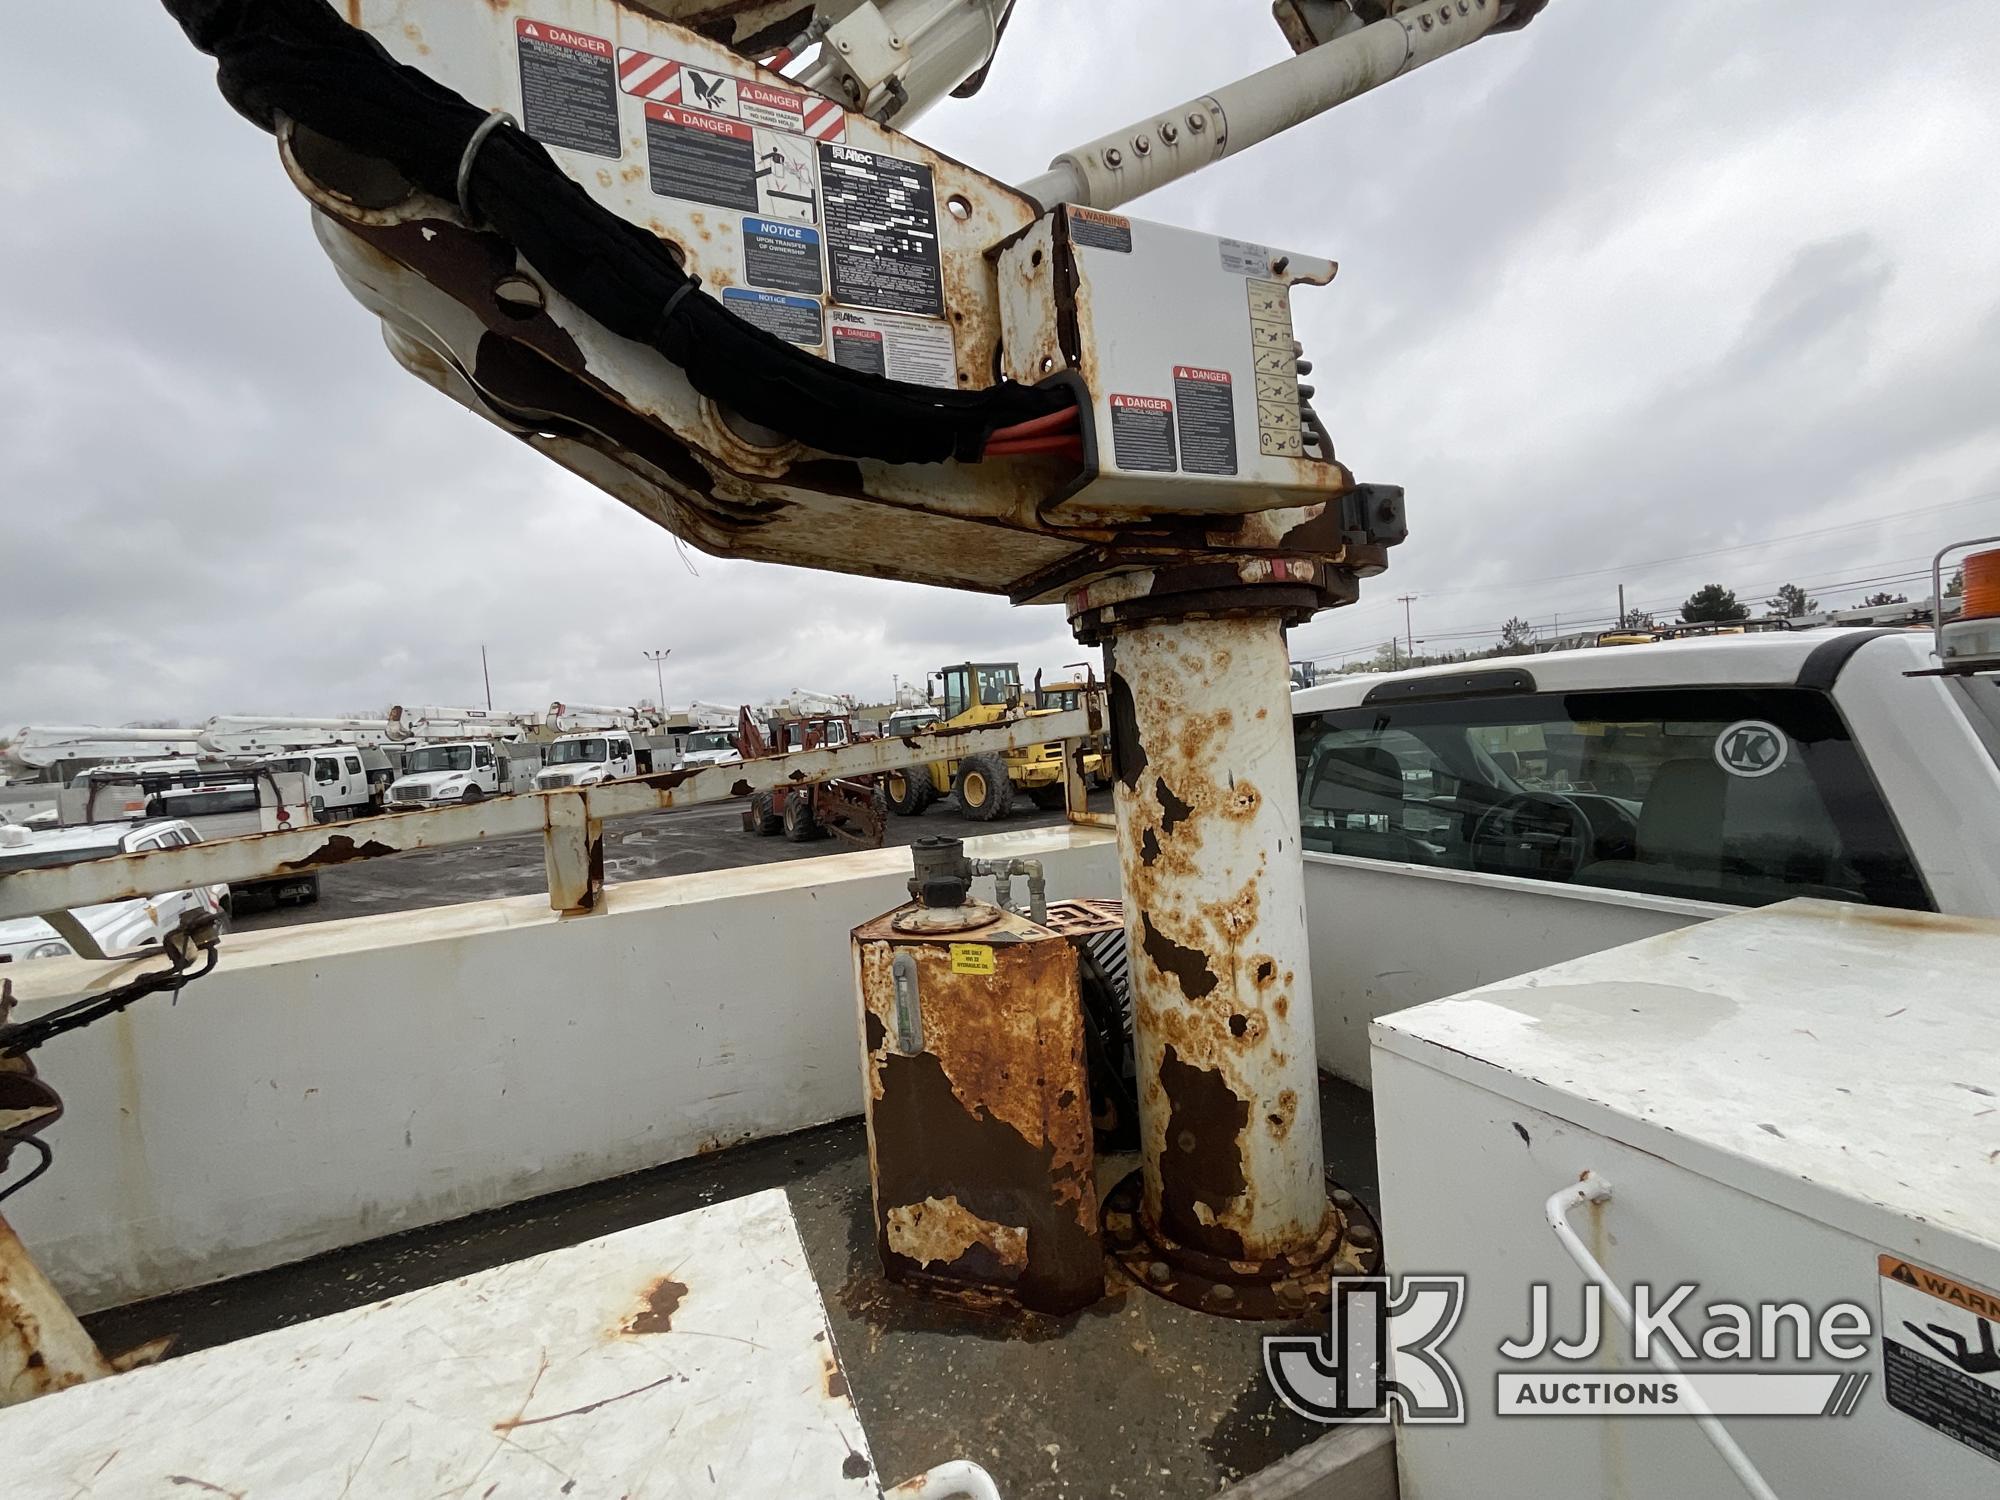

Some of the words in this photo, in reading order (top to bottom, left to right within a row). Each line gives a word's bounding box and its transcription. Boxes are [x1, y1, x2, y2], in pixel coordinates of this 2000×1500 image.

[549, 29, 606, 53] DANGER
[754, 89, 800, 109] DANGER
[775, 112, 800, 122] HAZARD
[682, 113, 734, 135] DANGER
[845, 148, 874, 165] Altec
[1084, 211, 1128, 227] WARNING
[760, 223, 802, 239] NOTICE
[756, 236, 774, 245] UPON
[774, 238, 807, 250] TRANSFER
[768, 244, 806, 256] OWNERSHIP
[758, 293, 786, 304] NOTICE
[842, 312, 866, 325] Altec
[847, 328, 876, 339] DANGER
[1191, 369, 1228, 382] DANGER
[1126, 397, 1168, 410] DANGER
